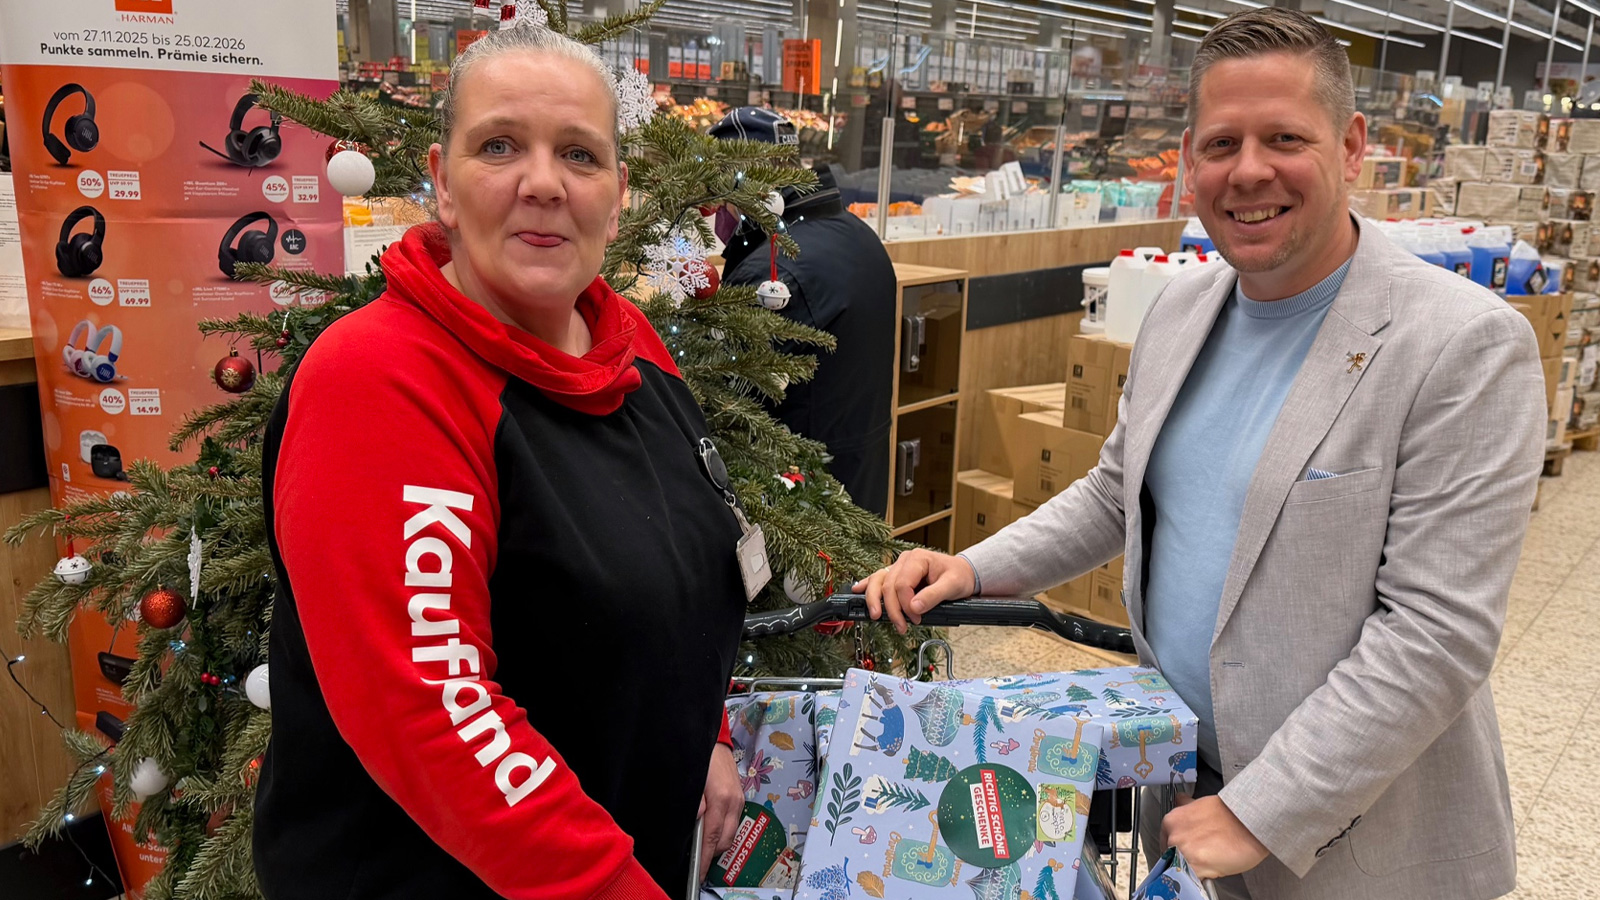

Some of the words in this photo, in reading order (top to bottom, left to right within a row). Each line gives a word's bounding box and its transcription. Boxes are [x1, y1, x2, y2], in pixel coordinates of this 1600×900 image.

[121, 14, 174, 24] HARMAN
[53, 31, 80, 42] vom
[83, 29, 148, 45] 27.11.2025
[152, 33, 171, 46] bis
[174, 34, 246, 50] 25.02.2026
[40, 42, 84, 56] Punkte
[87, 46, 154, 59] sammeln.
[157, 48, 208, 63] Prämie
[211, 52, 264, 66] sichern.
[80, 178, 101, 187] 50%
[266, 183, 287, 192] 45%
[114, 190, 139, 198] 29.99
[297, 193, 318, 202] 32.99
[91, 285, 112, 295] 46%
[125, 297, 149, 305] 69.99
[102, 395, 123, 404] 40%
[137, 406, 160, 414] 14.99
[983, 772, 998, 813] RICHTIG
[973, 786, 990, 846] GESCHENKE
[745, 815, 767, 849] RICHTIG
[990, 813, 1006, 856] SCHÖNE
[139, 853, 164, 864] unter
[726, 848, 749, 883] SCHÖNE
